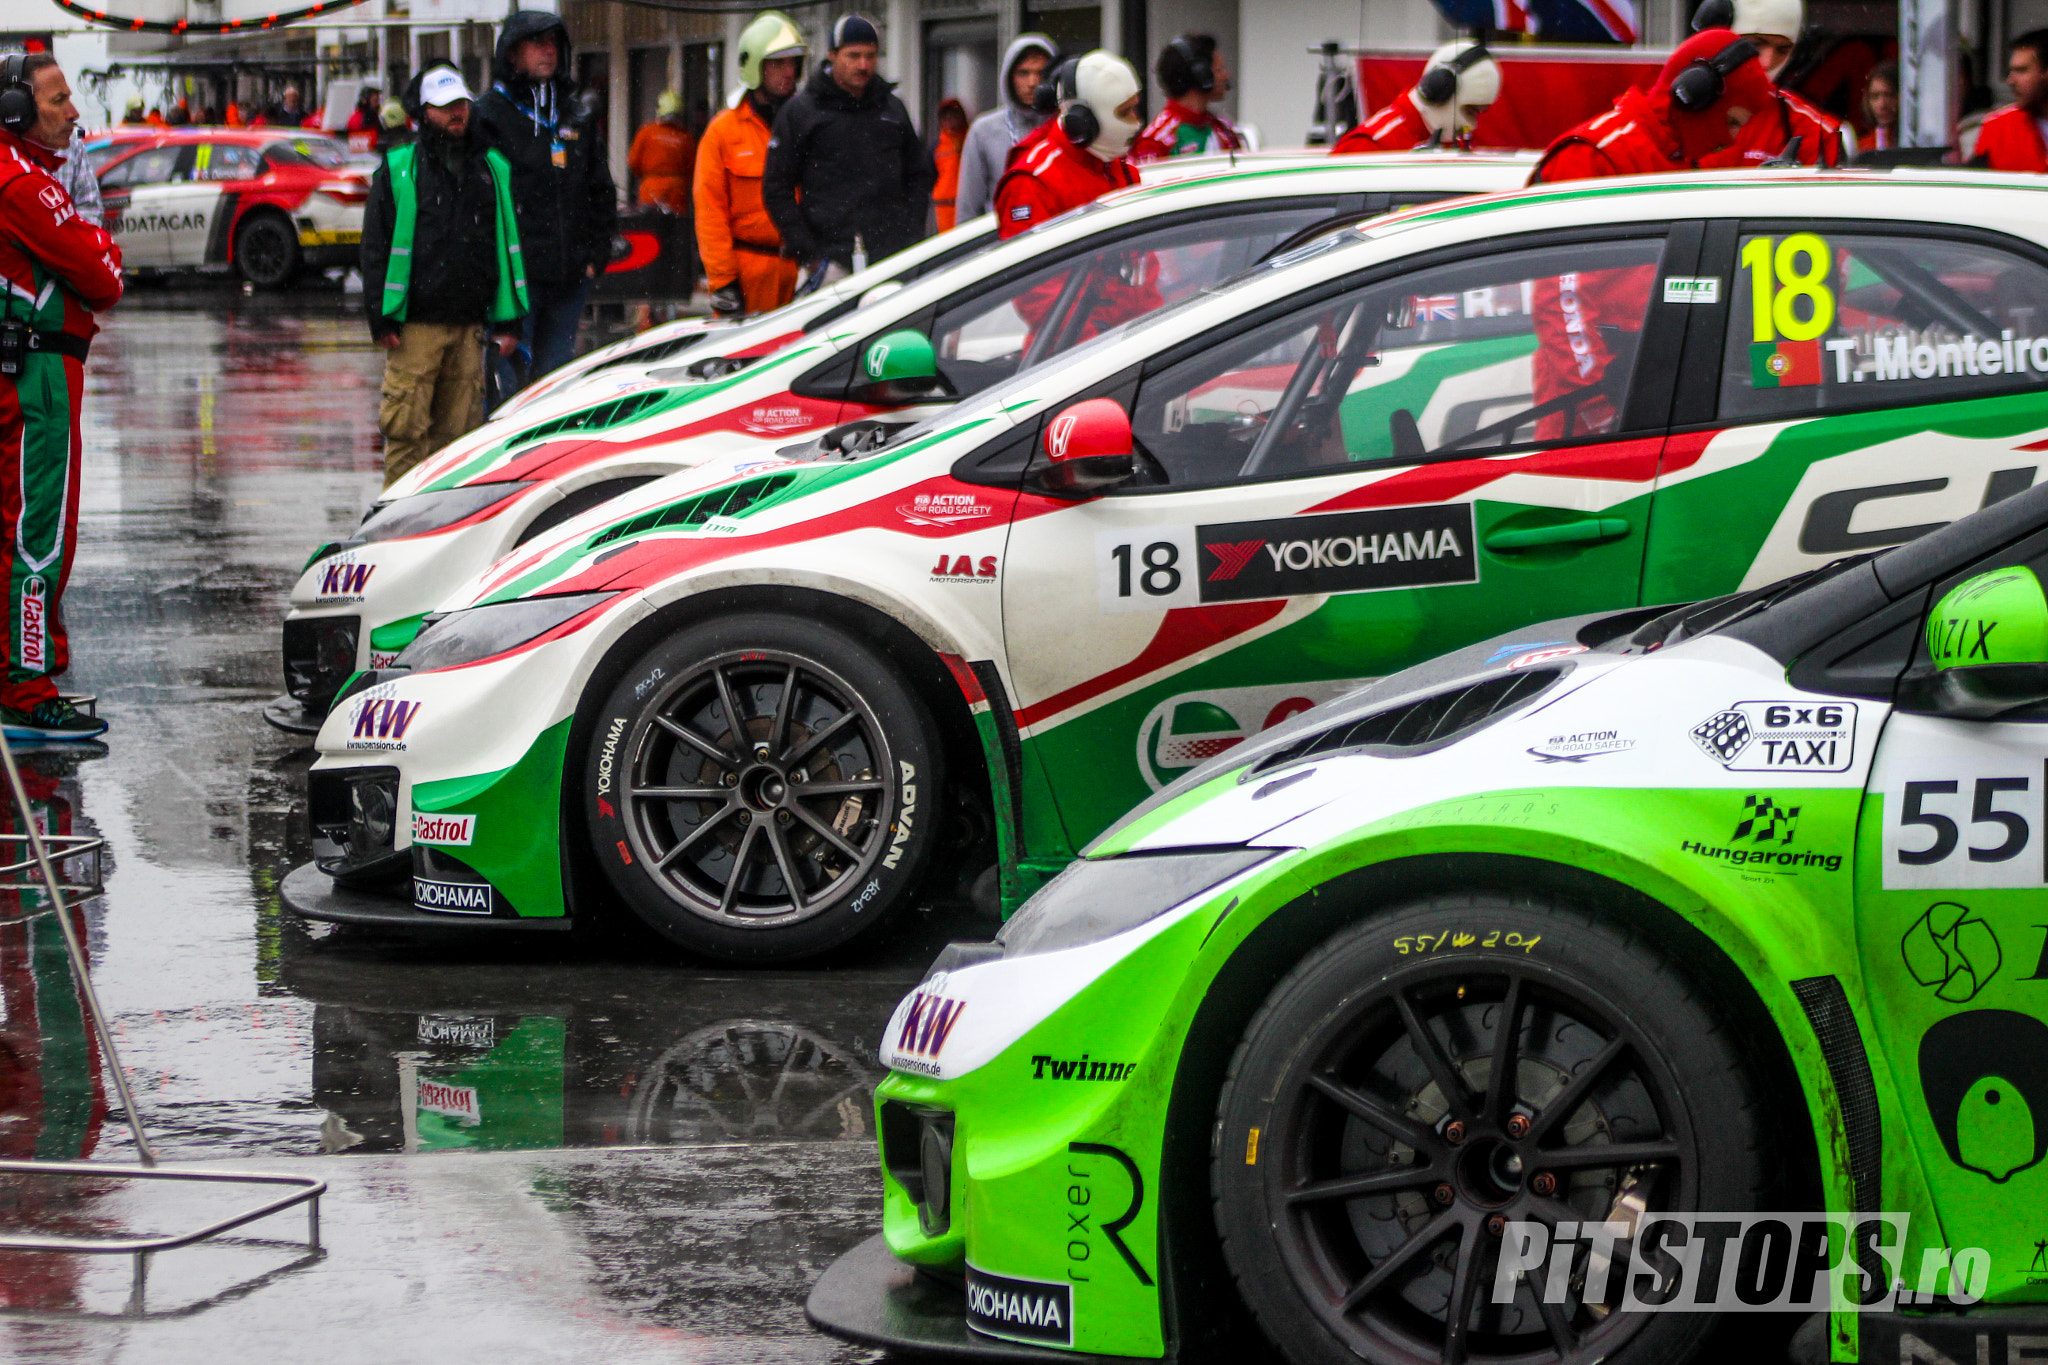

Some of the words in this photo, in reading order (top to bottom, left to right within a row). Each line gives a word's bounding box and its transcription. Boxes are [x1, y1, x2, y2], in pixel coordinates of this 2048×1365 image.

[1742, 232, 1835, 342] 18
[1825, 338, 1864, 384] T.
[1874, 329, 2048, 381] Monteiro
[764, 416, 784, 424] ROAD
[785, 416, 814, 424] SAFETY
[767, 408, 800, 417] ACTION
[914, 496, 930, 505] FIA
[932, 495, 975, 506] ACTION
[914, 505, 927, 513] FOR
[928, 505, 954, 515] ROAD
[955, 506, 992, 515] SAFETY
[930, 554, 998, 578] JAS
[1111, 541, 1181, 598] 18
[1265, 528, 1464, 573] YOKOHAMA
[320, 563, 377, 596] KW
[929, 577, 997, 585] MOTORSPORT
[23, 597, 44, 666] Castrol
[353, 699, 423, 741] KW
[1764, 705, 1844, 729] 6x6
[1562, 742, 1592, 752] ROAD
[1594, 738, 1636, 750] SAFETY
[1567, 730, 1618, 744] ACTION
[1761, 740, 1837, 766] TAXI
[598, 717, 628, 797] YOKOHAMA
[417, 815, 469, 841] Castrol
[882, 760, 916, 870] ADVAN
[1897, 776, 2030, 866] 55
[1680, 840, 1843, 872] Hungaroring
[414, 880, 487, 908] YOKOHAMA
[897, 991, 967, 1061] KW
[1067, 1164, 1091, 1283] roxer
[966, 1280, 1063, 1329] YOKOHAMA
